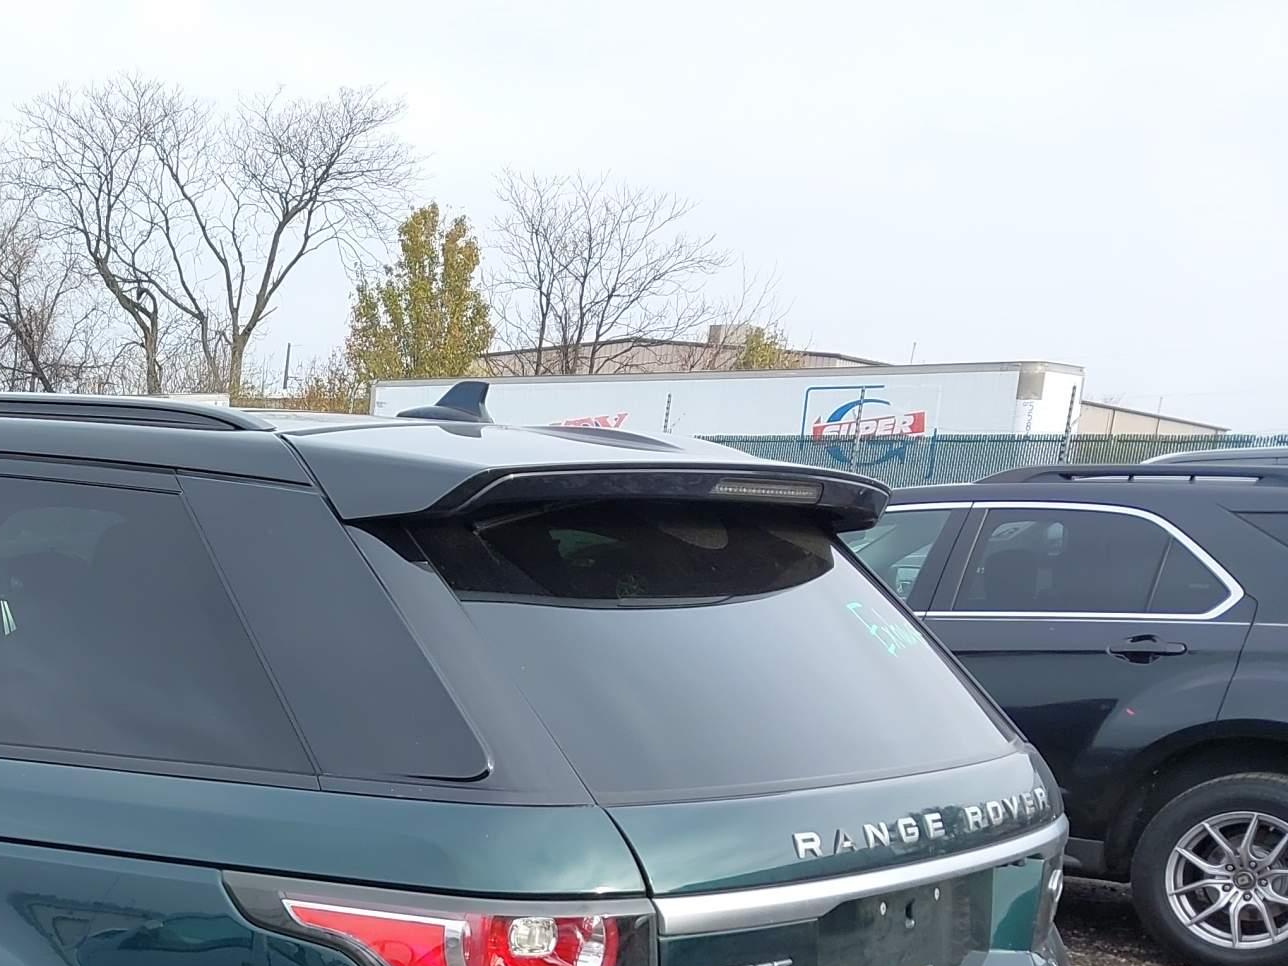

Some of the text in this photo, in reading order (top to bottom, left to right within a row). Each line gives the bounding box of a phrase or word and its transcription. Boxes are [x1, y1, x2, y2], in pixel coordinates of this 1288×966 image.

[822, 415, 915, 438] SUPER
[792, 786, 1050, 859] RANGE ROVER
